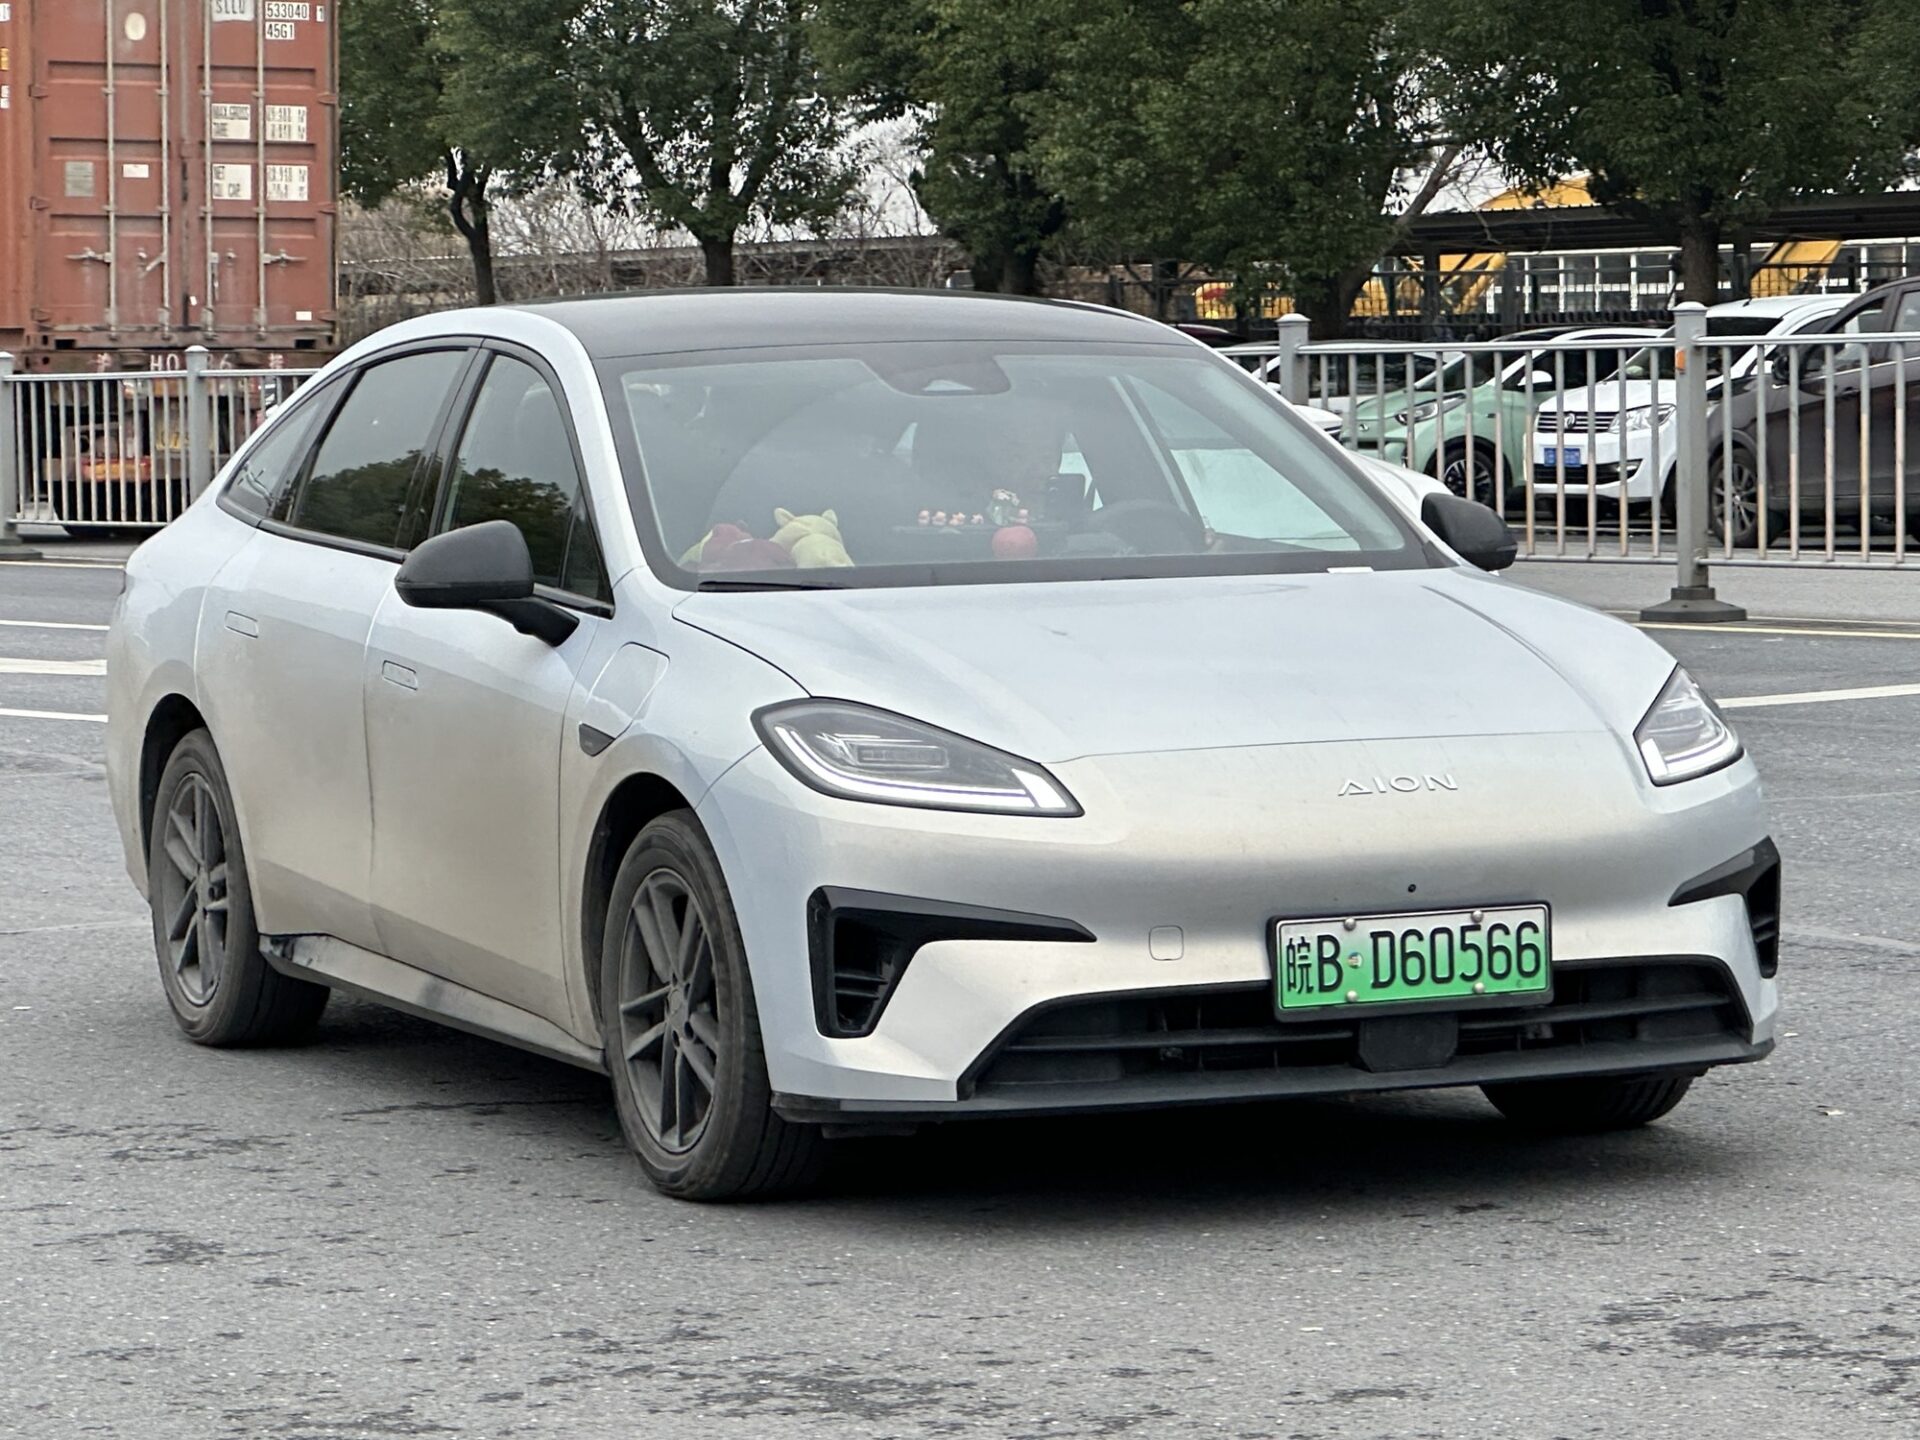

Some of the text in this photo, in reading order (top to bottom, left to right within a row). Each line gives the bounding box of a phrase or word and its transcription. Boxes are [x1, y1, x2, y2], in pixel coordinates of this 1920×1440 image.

[266, 3, 308, 19] 533040
[266, 23, 293, 38] 45G1
[1337, 773, 1458, 796] AION
[1370, 921, 1541, 989] D60566
